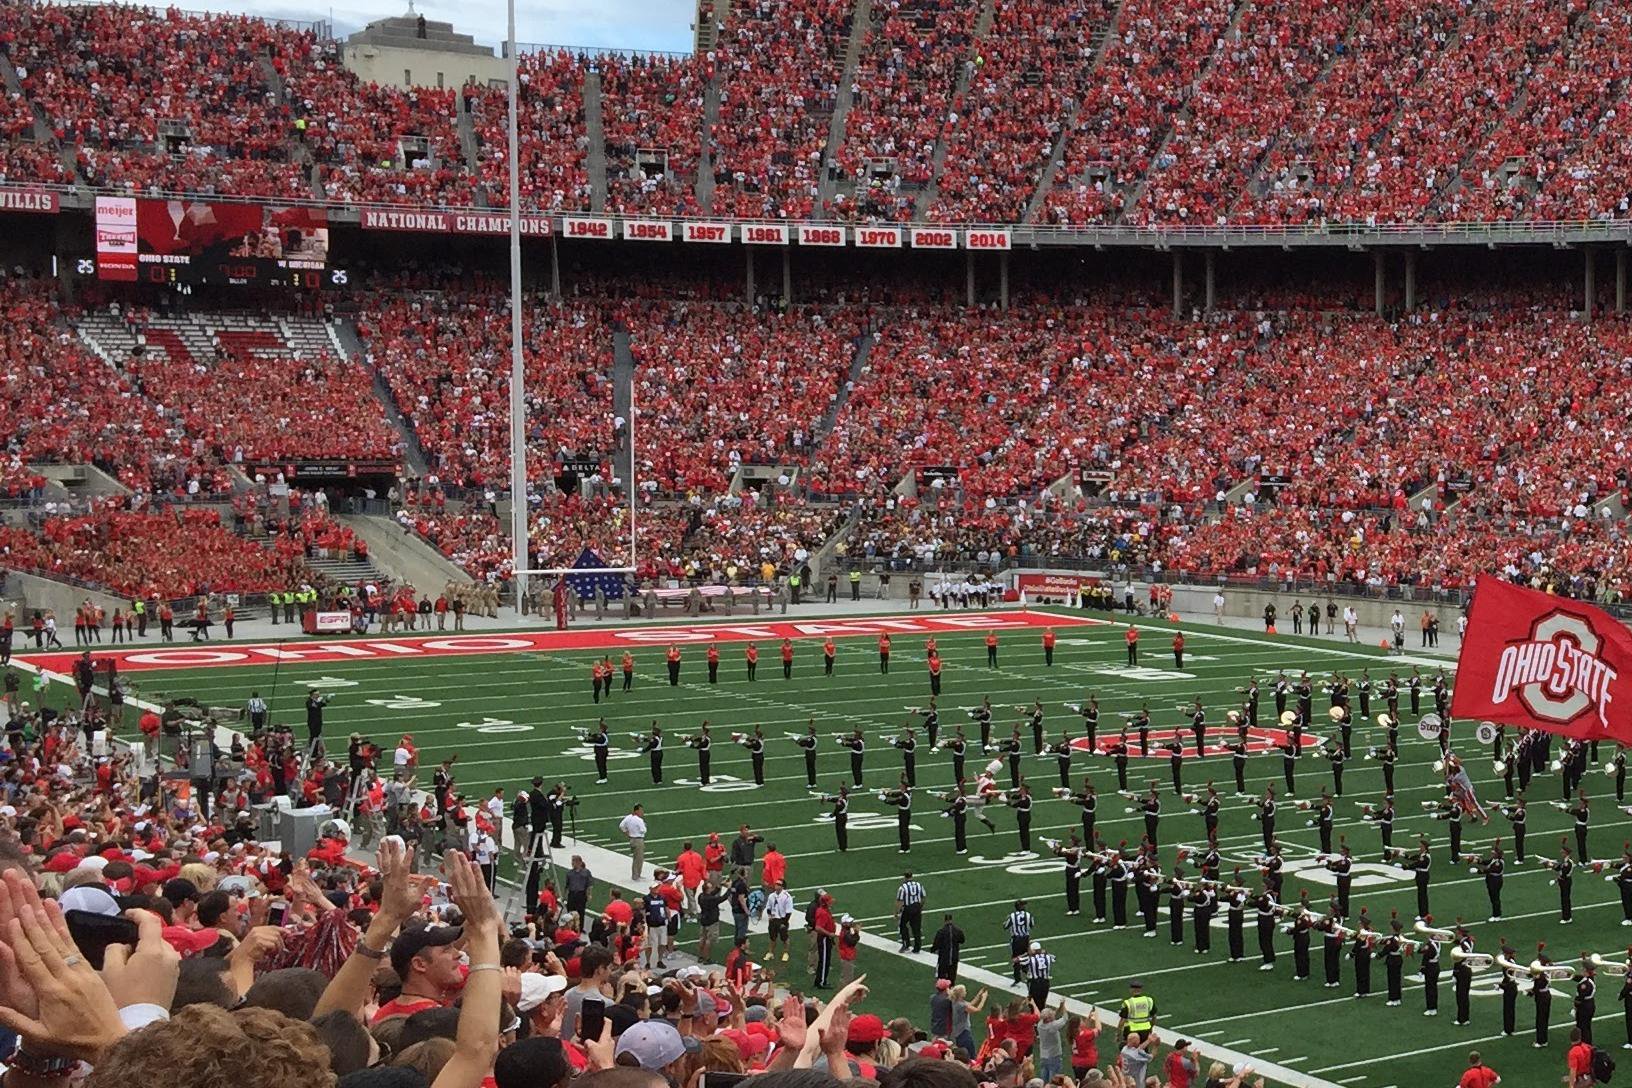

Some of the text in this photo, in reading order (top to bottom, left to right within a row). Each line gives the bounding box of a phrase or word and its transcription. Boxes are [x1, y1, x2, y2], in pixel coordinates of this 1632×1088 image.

[98, 204, 133, 217] meijer
[367, 212, 549, 234] NATIONAL CHAMPONS
[569, 222, 607, 236] 1942
[629, 224, 666, 238] 1954
[688, 225, 725, 240] 1957
[747, 228, 782, 242] 1961
[803, 229, 840, 244] 1968
[860, 231, 896, 245] 1970
[915, 232, 952, 246] 2002
[969, 233, 1006, 247] 2014
[139, 254, 190, 264] OHIO STATE
[332, 270, 348, 284] 25
[319, 615, 349, 624] ESPN
[124, 616, 1029, 666] OHIO STATE
[1491, 638, 1618, 729] OHIO STATE
[909, 884, 917, 897] U
[1017, 914, 1025, 926] C
